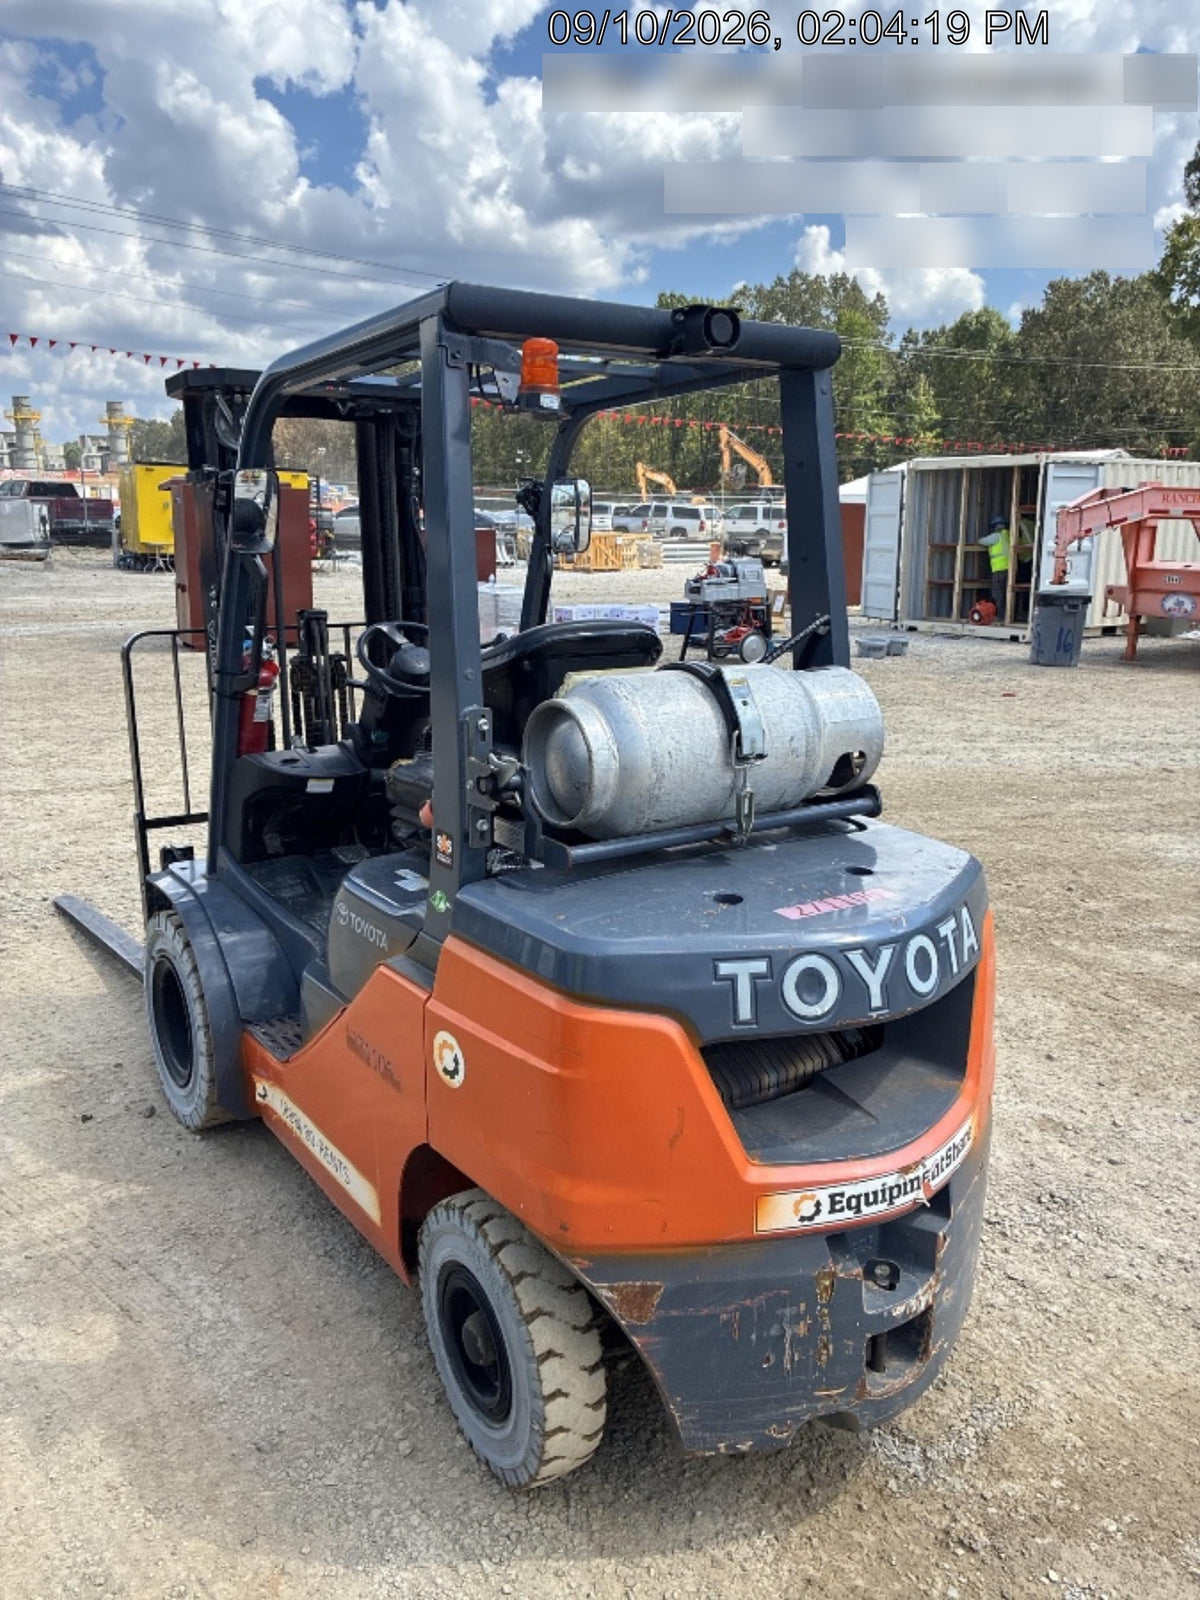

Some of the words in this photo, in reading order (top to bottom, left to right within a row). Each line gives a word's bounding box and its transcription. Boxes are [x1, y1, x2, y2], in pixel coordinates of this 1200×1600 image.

[1056, 626, 1073, 653] 16
[349, 912, 388, 952] TOYOTA
[714, 903, 979, 1026] TOYOTA
